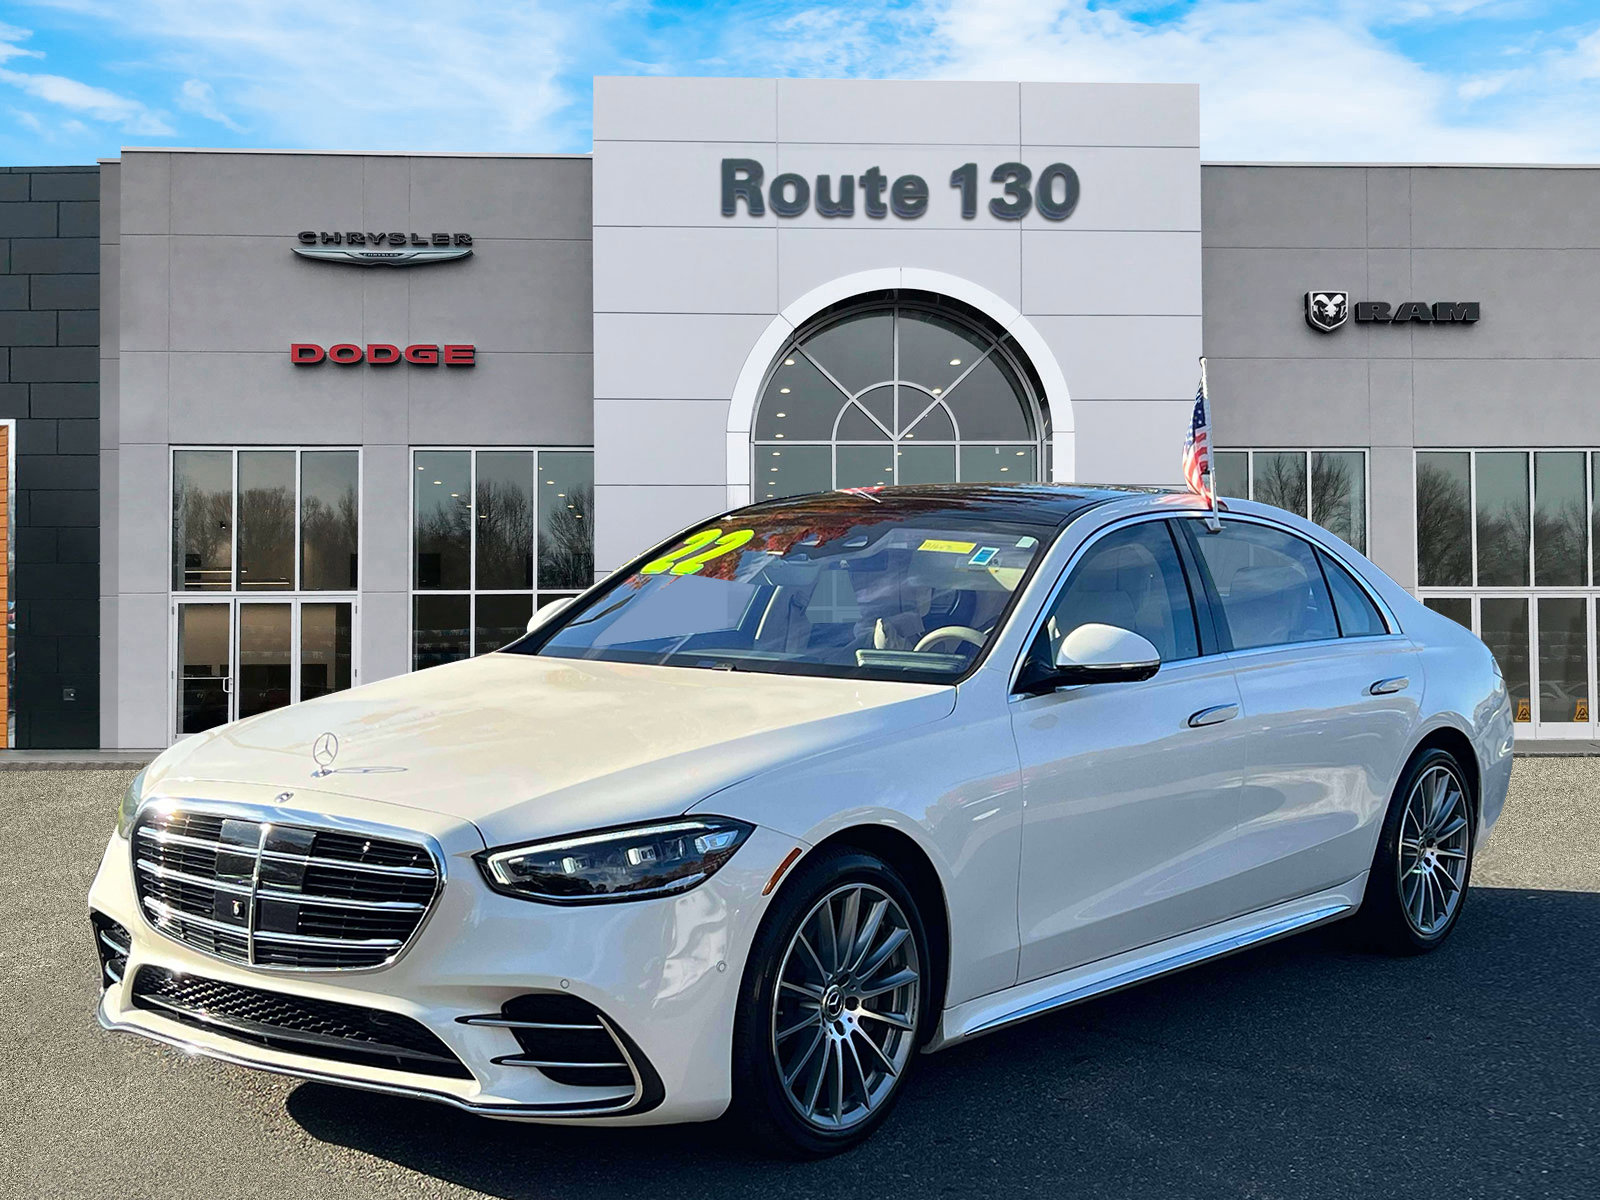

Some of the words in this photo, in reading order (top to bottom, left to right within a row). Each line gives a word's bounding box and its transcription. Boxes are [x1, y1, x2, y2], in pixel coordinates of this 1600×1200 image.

[721, 158, 929, 218] Route
[950, 161, 1080, 220] 130
[298, 231, 472, 246] CHRYSLER
[1355, 302, 1480, 323] RAM
[291, 344, 475, 365] DODGE
[640, 528, 755, 575] 22
